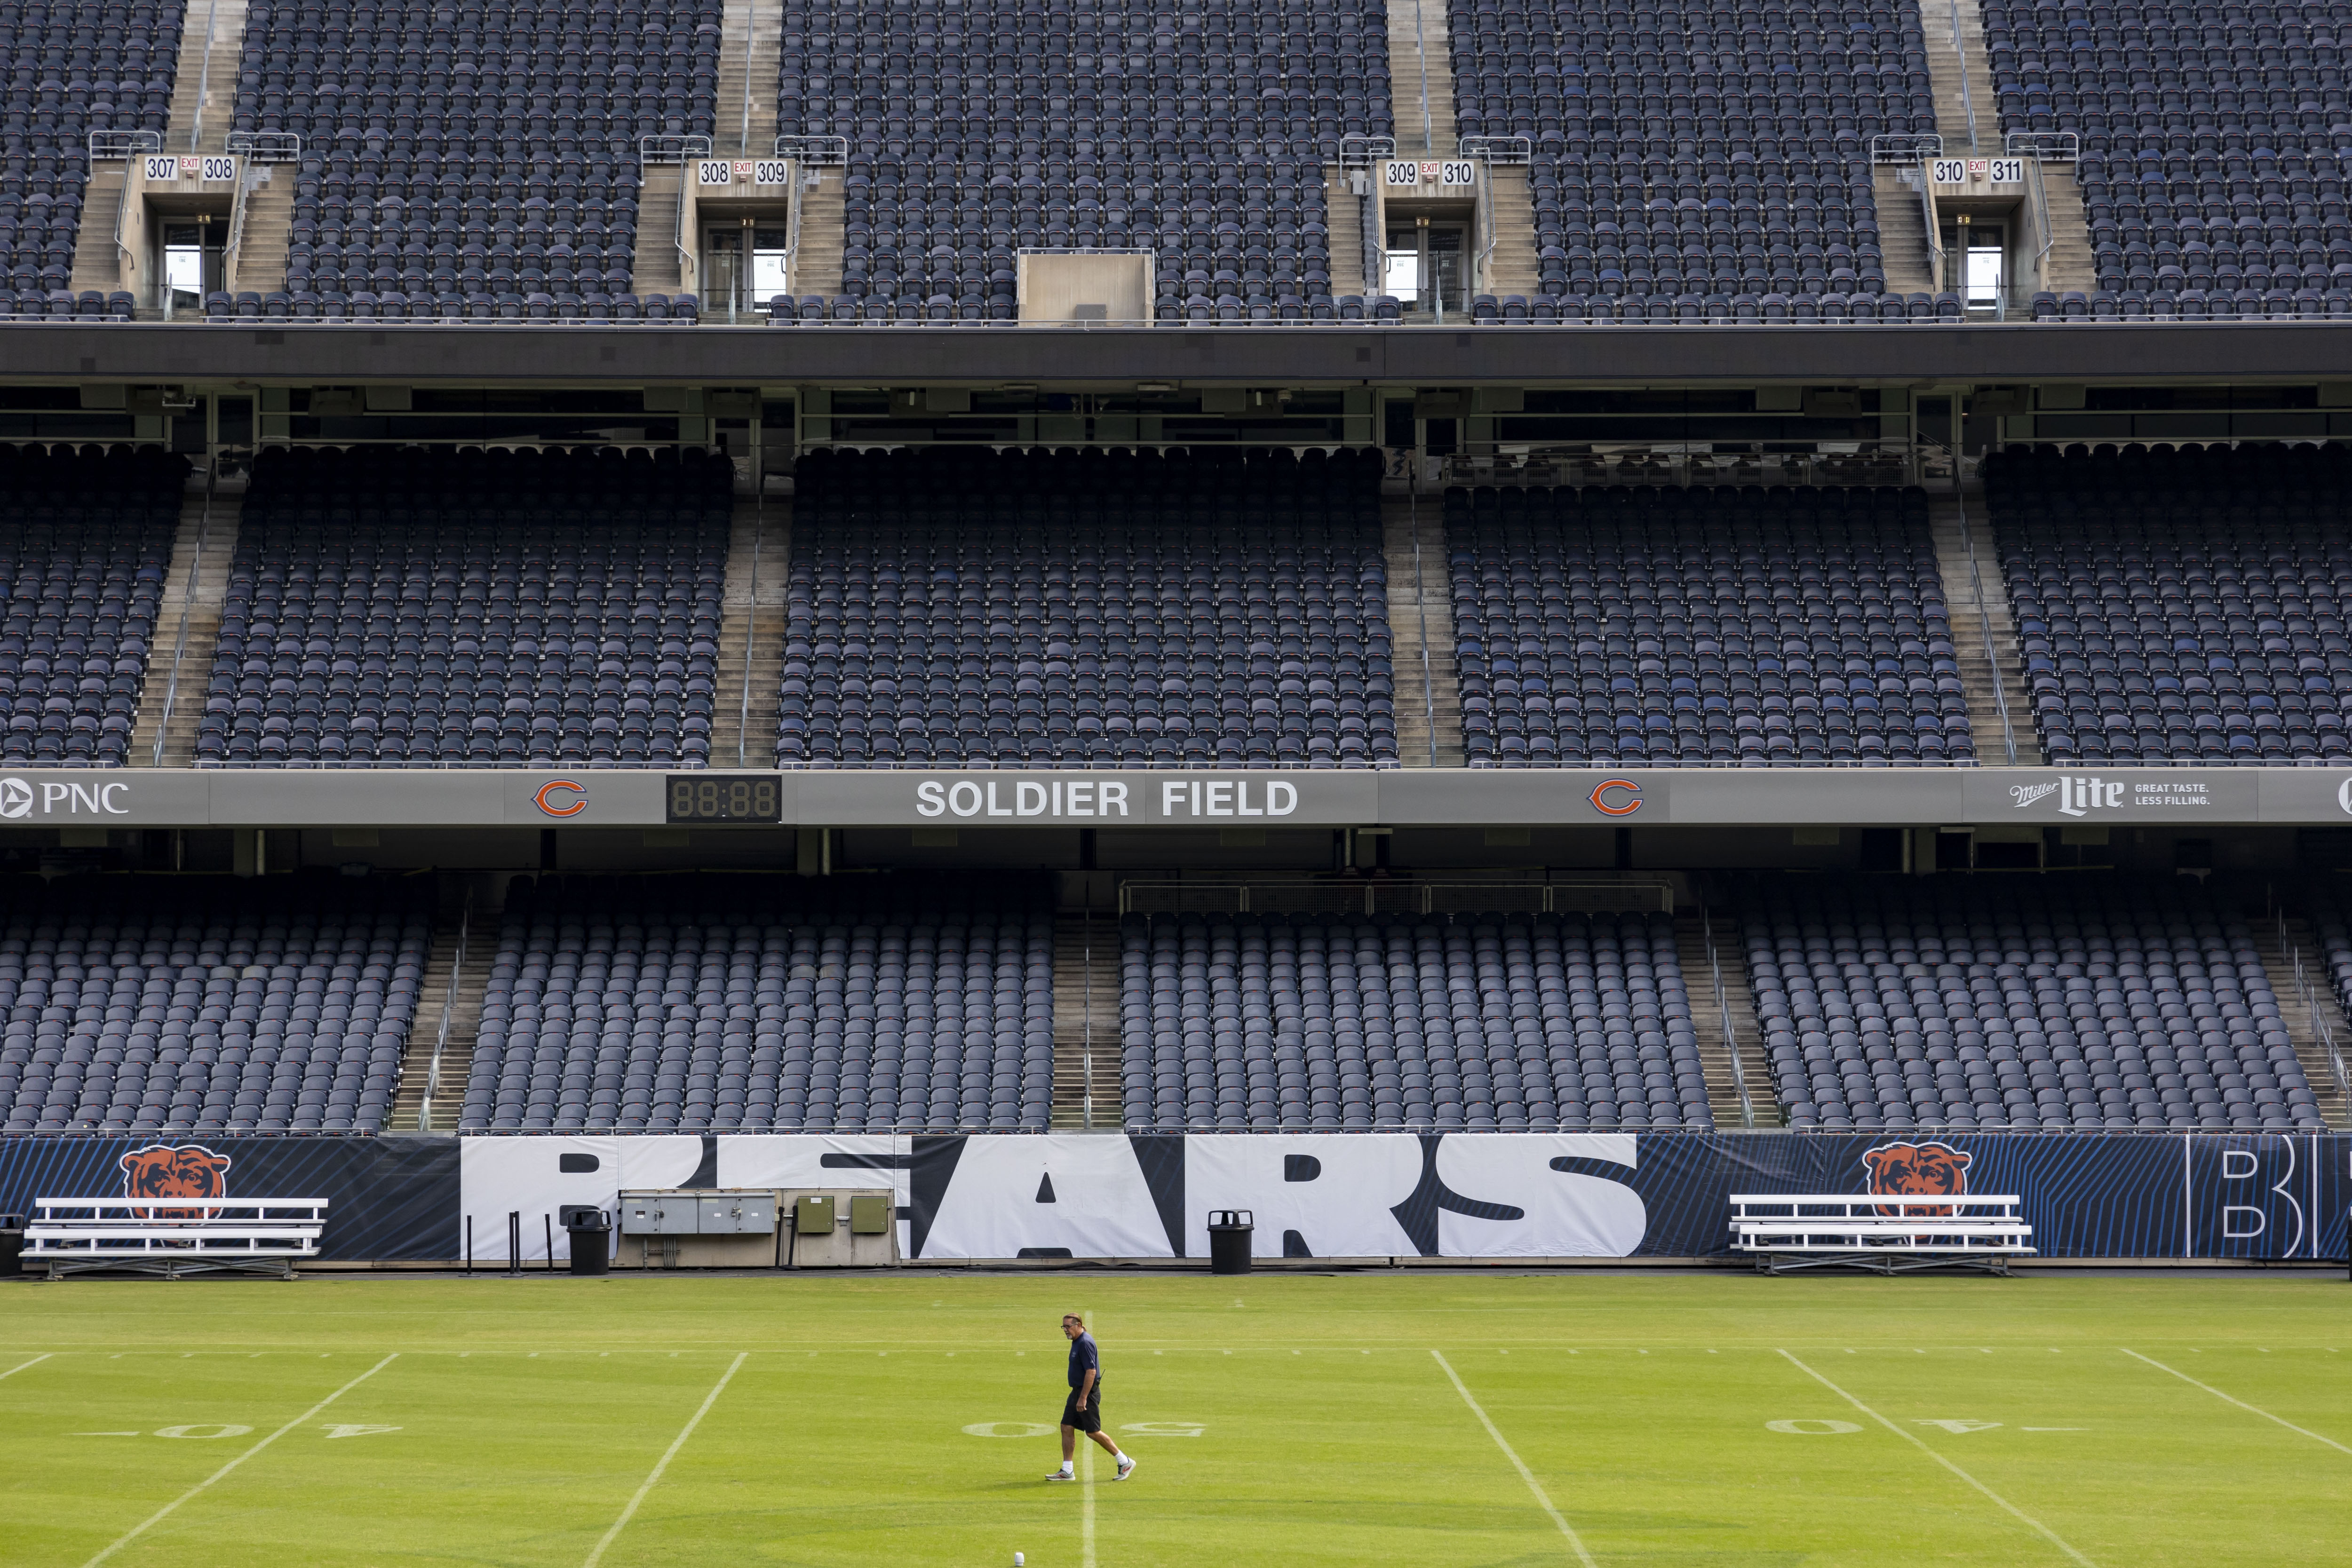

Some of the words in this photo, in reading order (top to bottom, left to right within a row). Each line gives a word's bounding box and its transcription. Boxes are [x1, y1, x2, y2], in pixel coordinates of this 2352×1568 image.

[148, 159, 174, 178] 307
[182, 158, 198, 167] EXIT
[206, 159, 232, 178] 308
[735, 163, 751, 172] EXIT
[1422, 164, 1438, 172] EXIT
[1936, 162, 1963, 181] 310
[1970, 162, 1986, 170] EXIT
[1993, 161, 2019, 181] 311
[702, 163, 728, 182] 308
[758, 163, 784, 182] 309
[1389, 164, 1415, 183] 309
[1445, 163, 1471, 183] 310
[40, 783, 128, 813] PNC
[917, 781, 1128, 816] SOLDIER
[1163, 781, 1297, 815] FIELD
[2010, 783, 2059, 807] Miller
[2058, 777, 2124, 816] Lite
